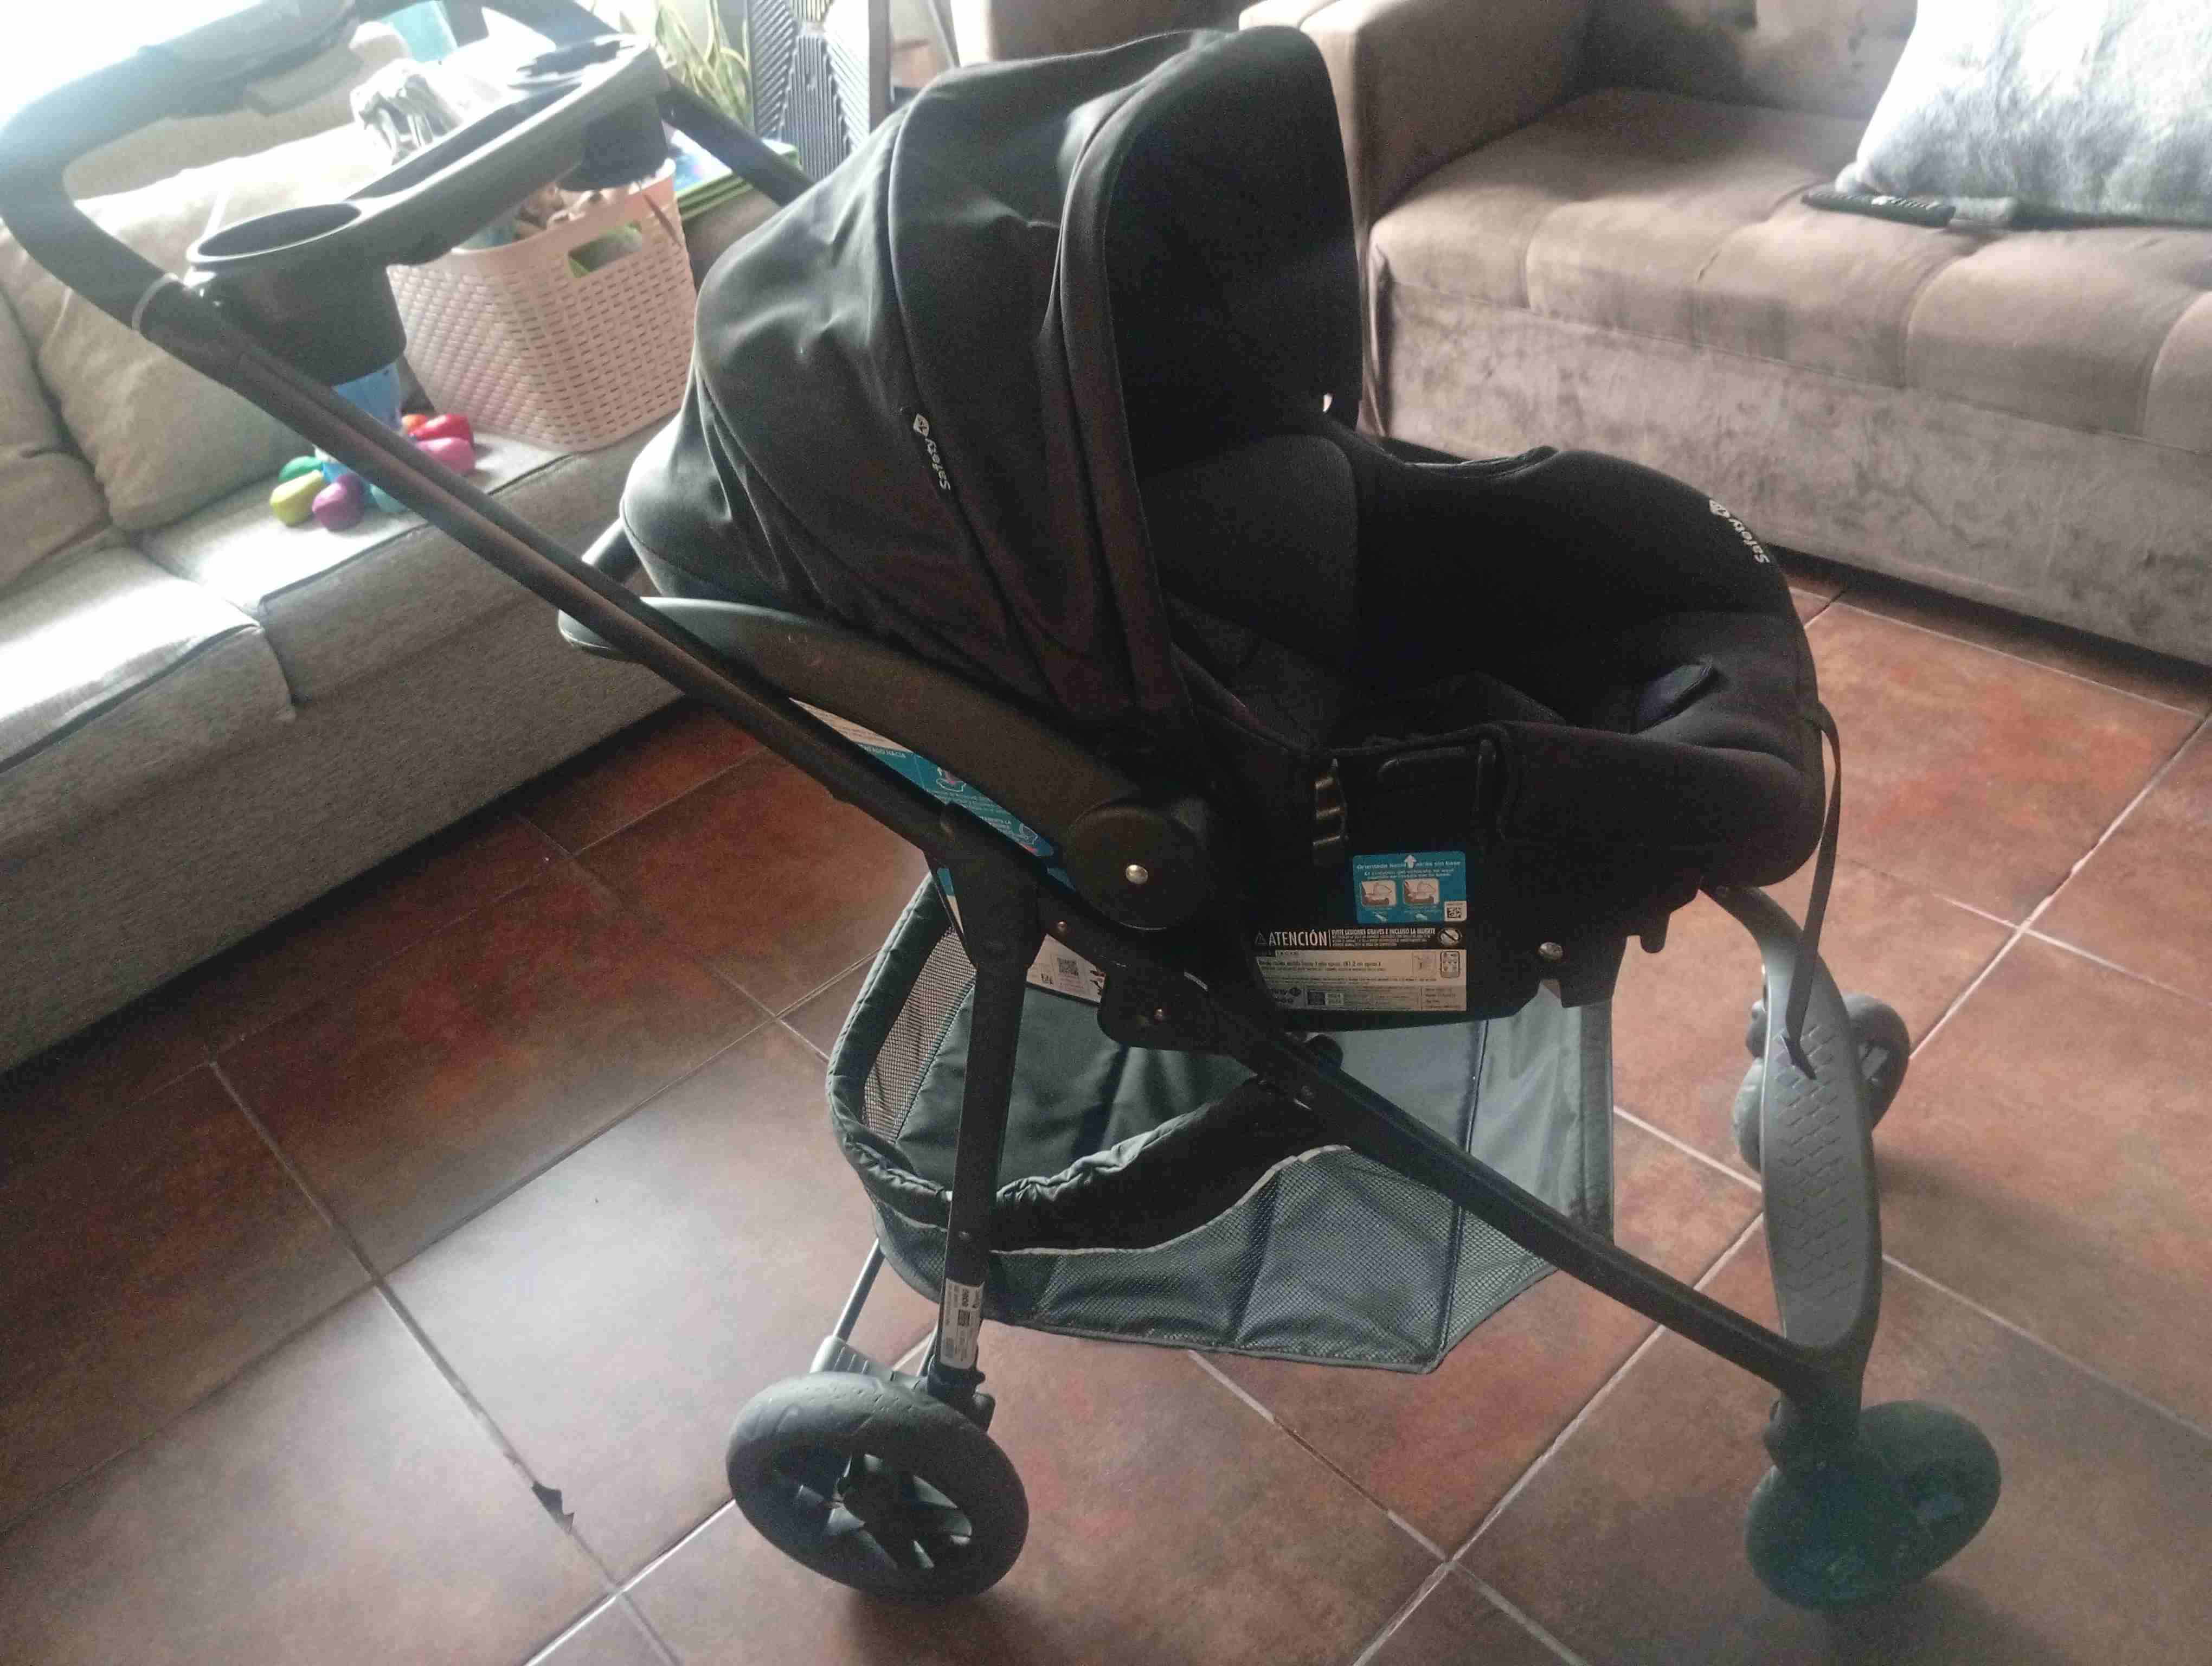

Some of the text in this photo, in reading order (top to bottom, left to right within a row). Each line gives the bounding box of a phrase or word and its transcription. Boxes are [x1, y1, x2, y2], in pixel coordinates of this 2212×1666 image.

[925, 438, 951, 490] Safety
[1728, 518, 1770, 563] Safety
[1269, 929, 1327, 946] ATENCIÓN
